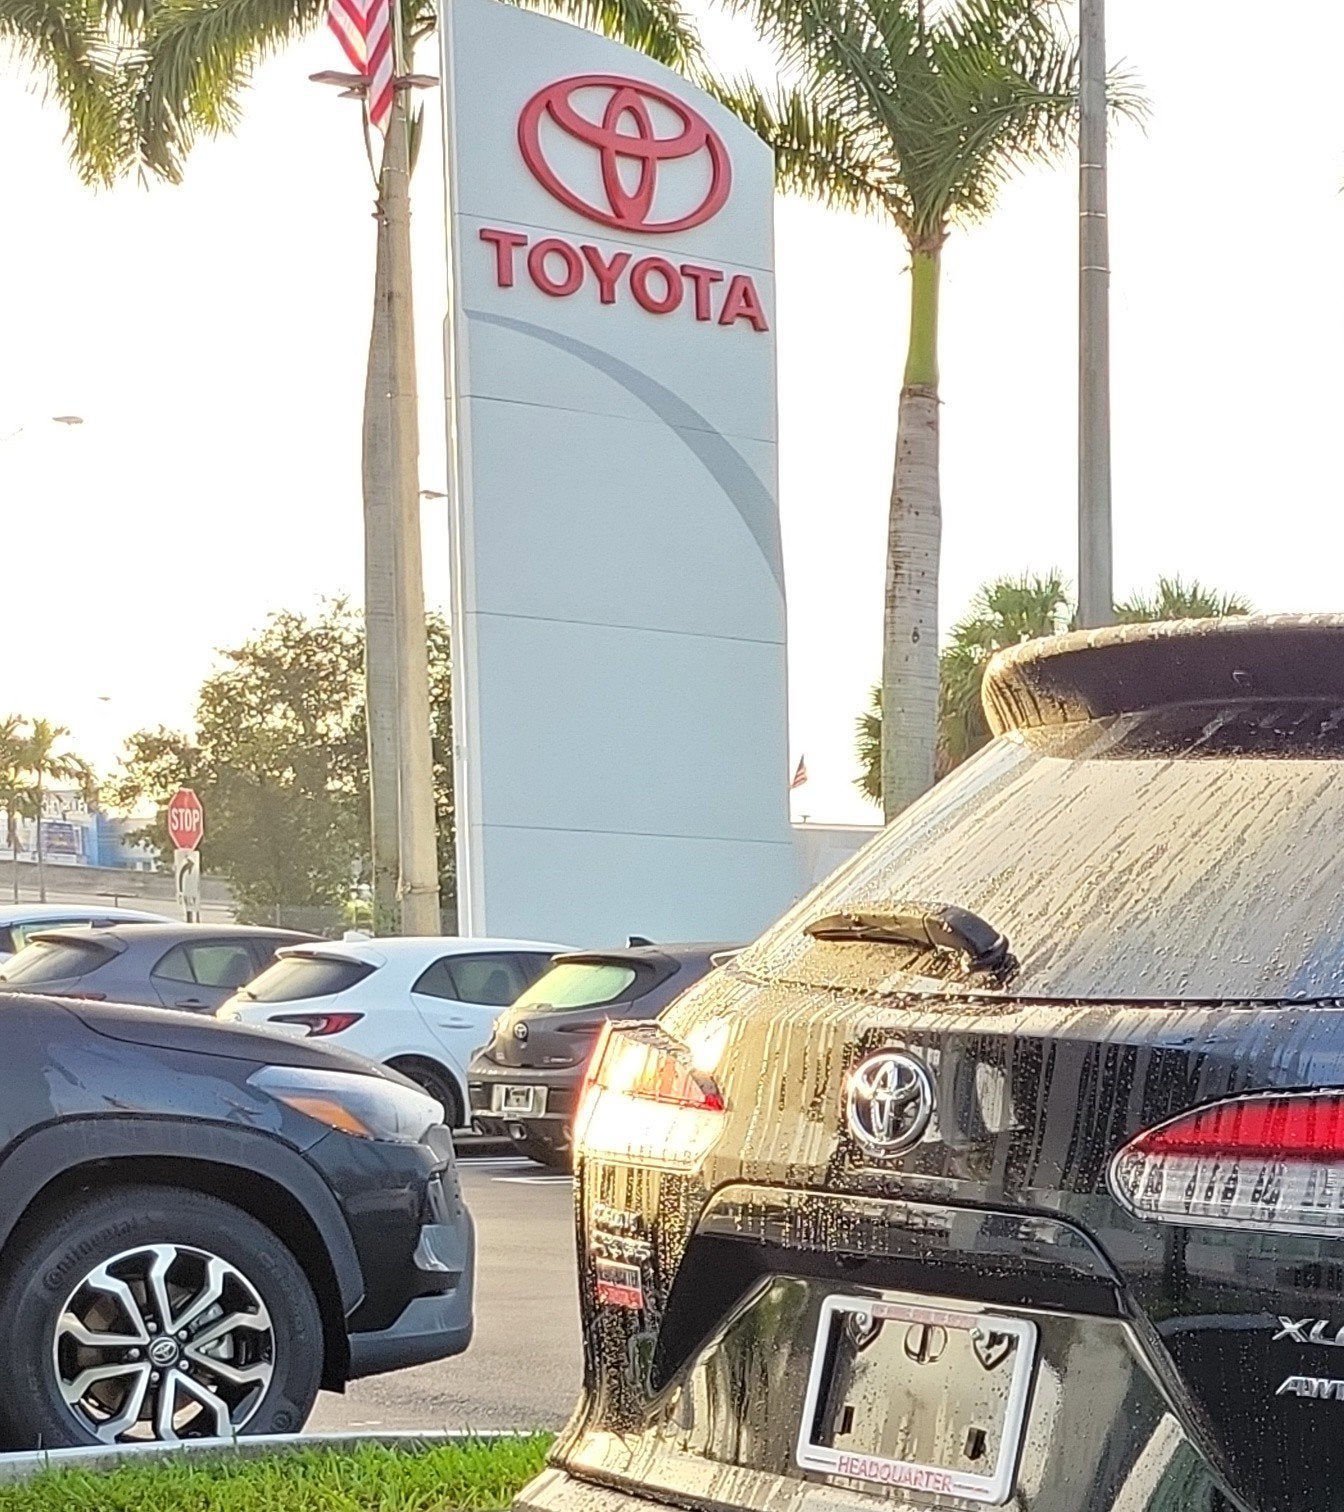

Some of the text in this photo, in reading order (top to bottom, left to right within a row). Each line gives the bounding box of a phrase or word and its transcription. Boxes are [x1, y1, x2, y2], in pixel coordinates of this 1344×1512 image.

[479, 228, 769, 332] TOYOTA
[171, 808, 199, 832] STOP
[838, 1455, 954, 1492] HEADQUARTER
